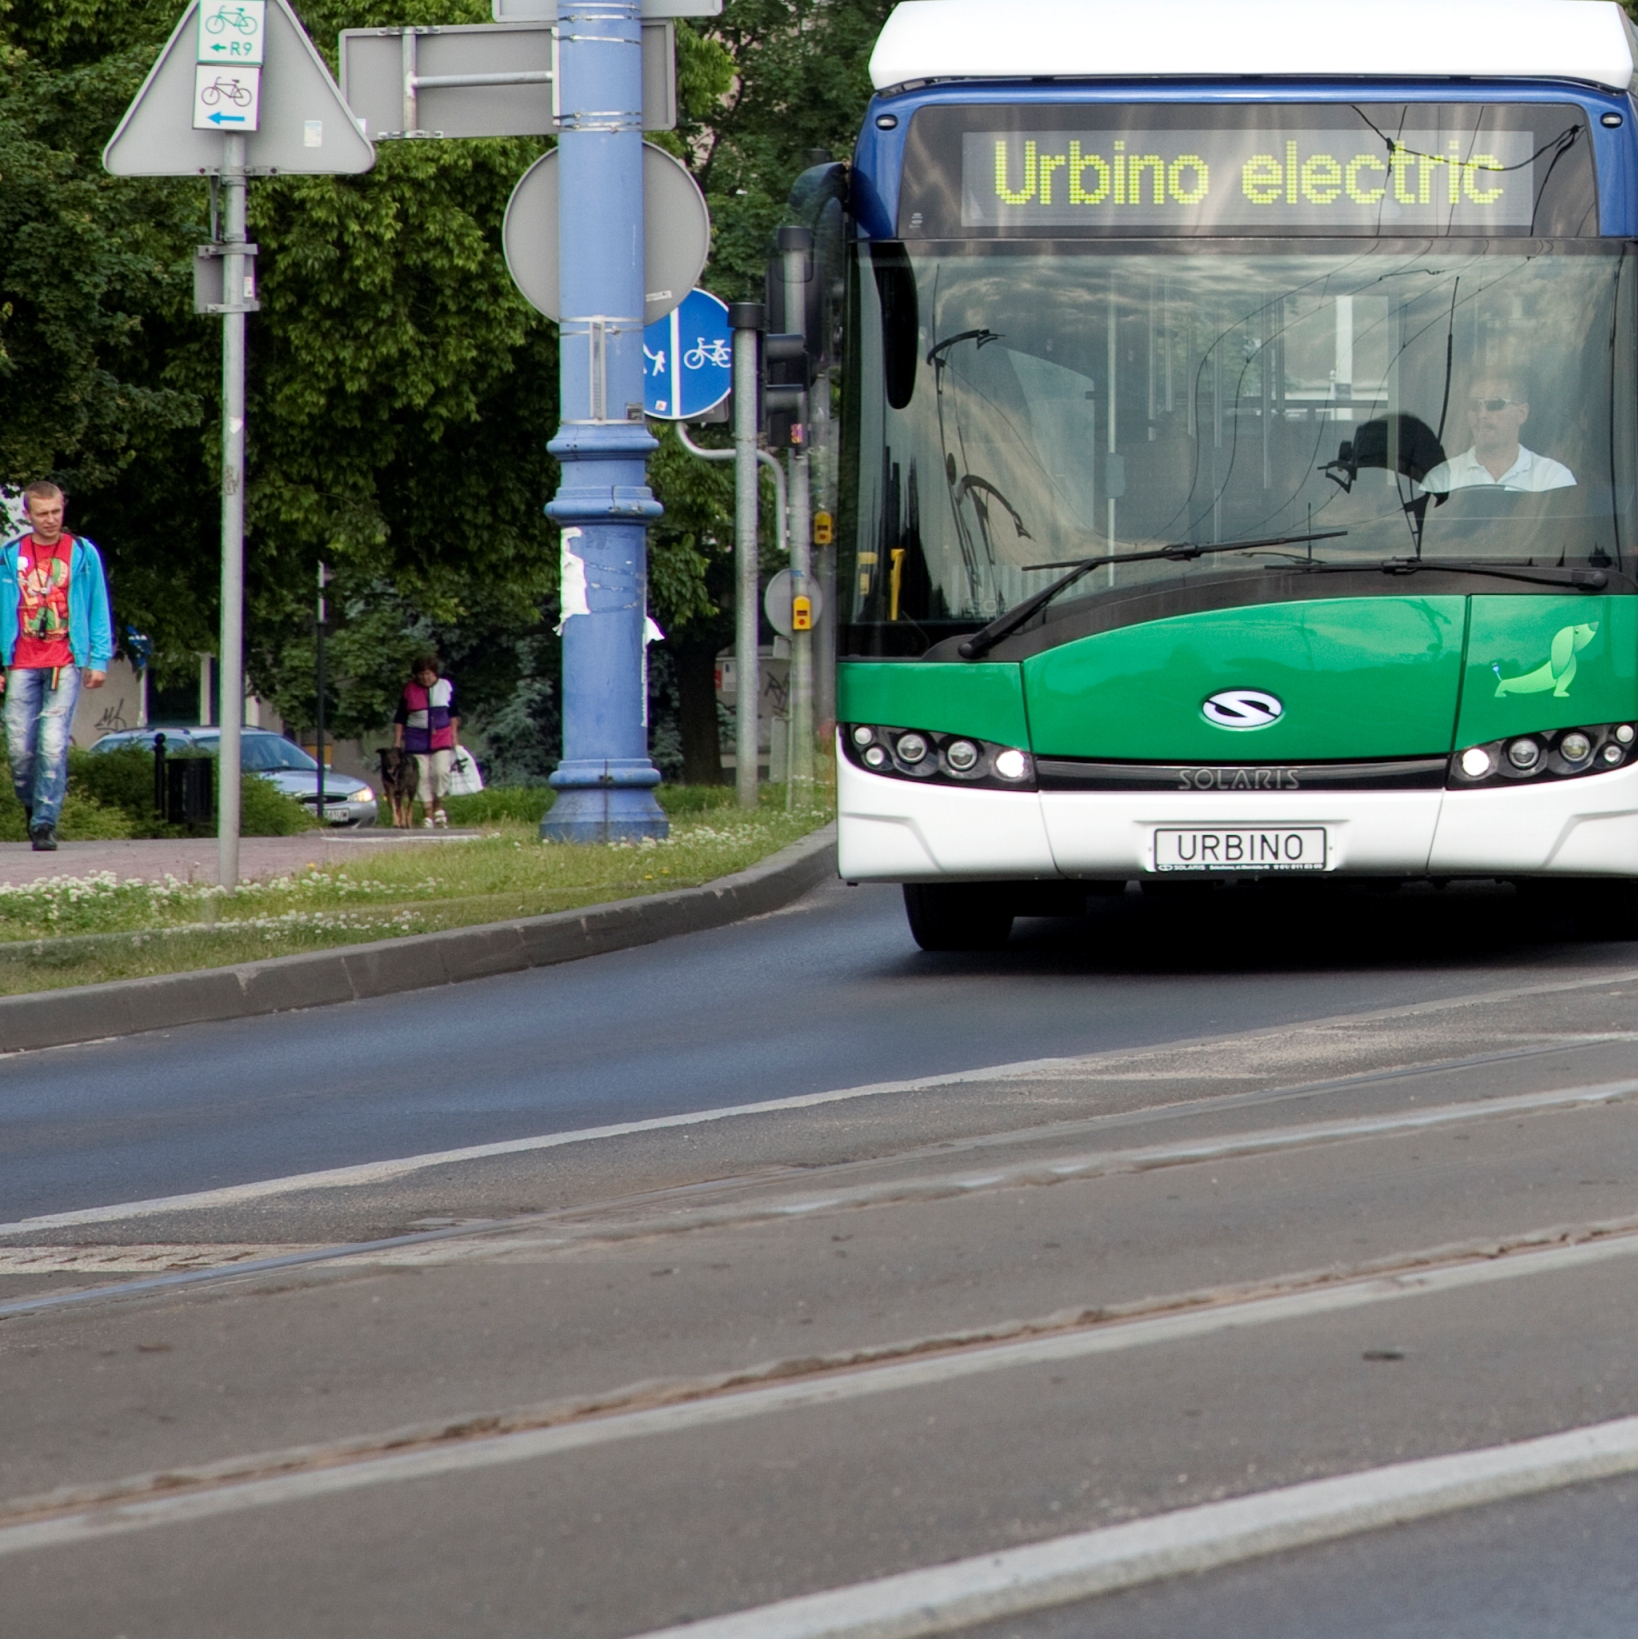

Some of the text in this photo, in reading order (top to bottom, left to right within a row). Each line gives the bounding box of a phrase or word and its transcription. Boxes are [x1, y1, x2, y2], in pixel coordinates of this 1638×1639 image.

[230, 41, 253, 56] R9
[995, 140, 1503, 205] Urbino electric
[1178, 769, 1300, 790] SOLARIS
[1178, 834, 1303, 861] URBINO
